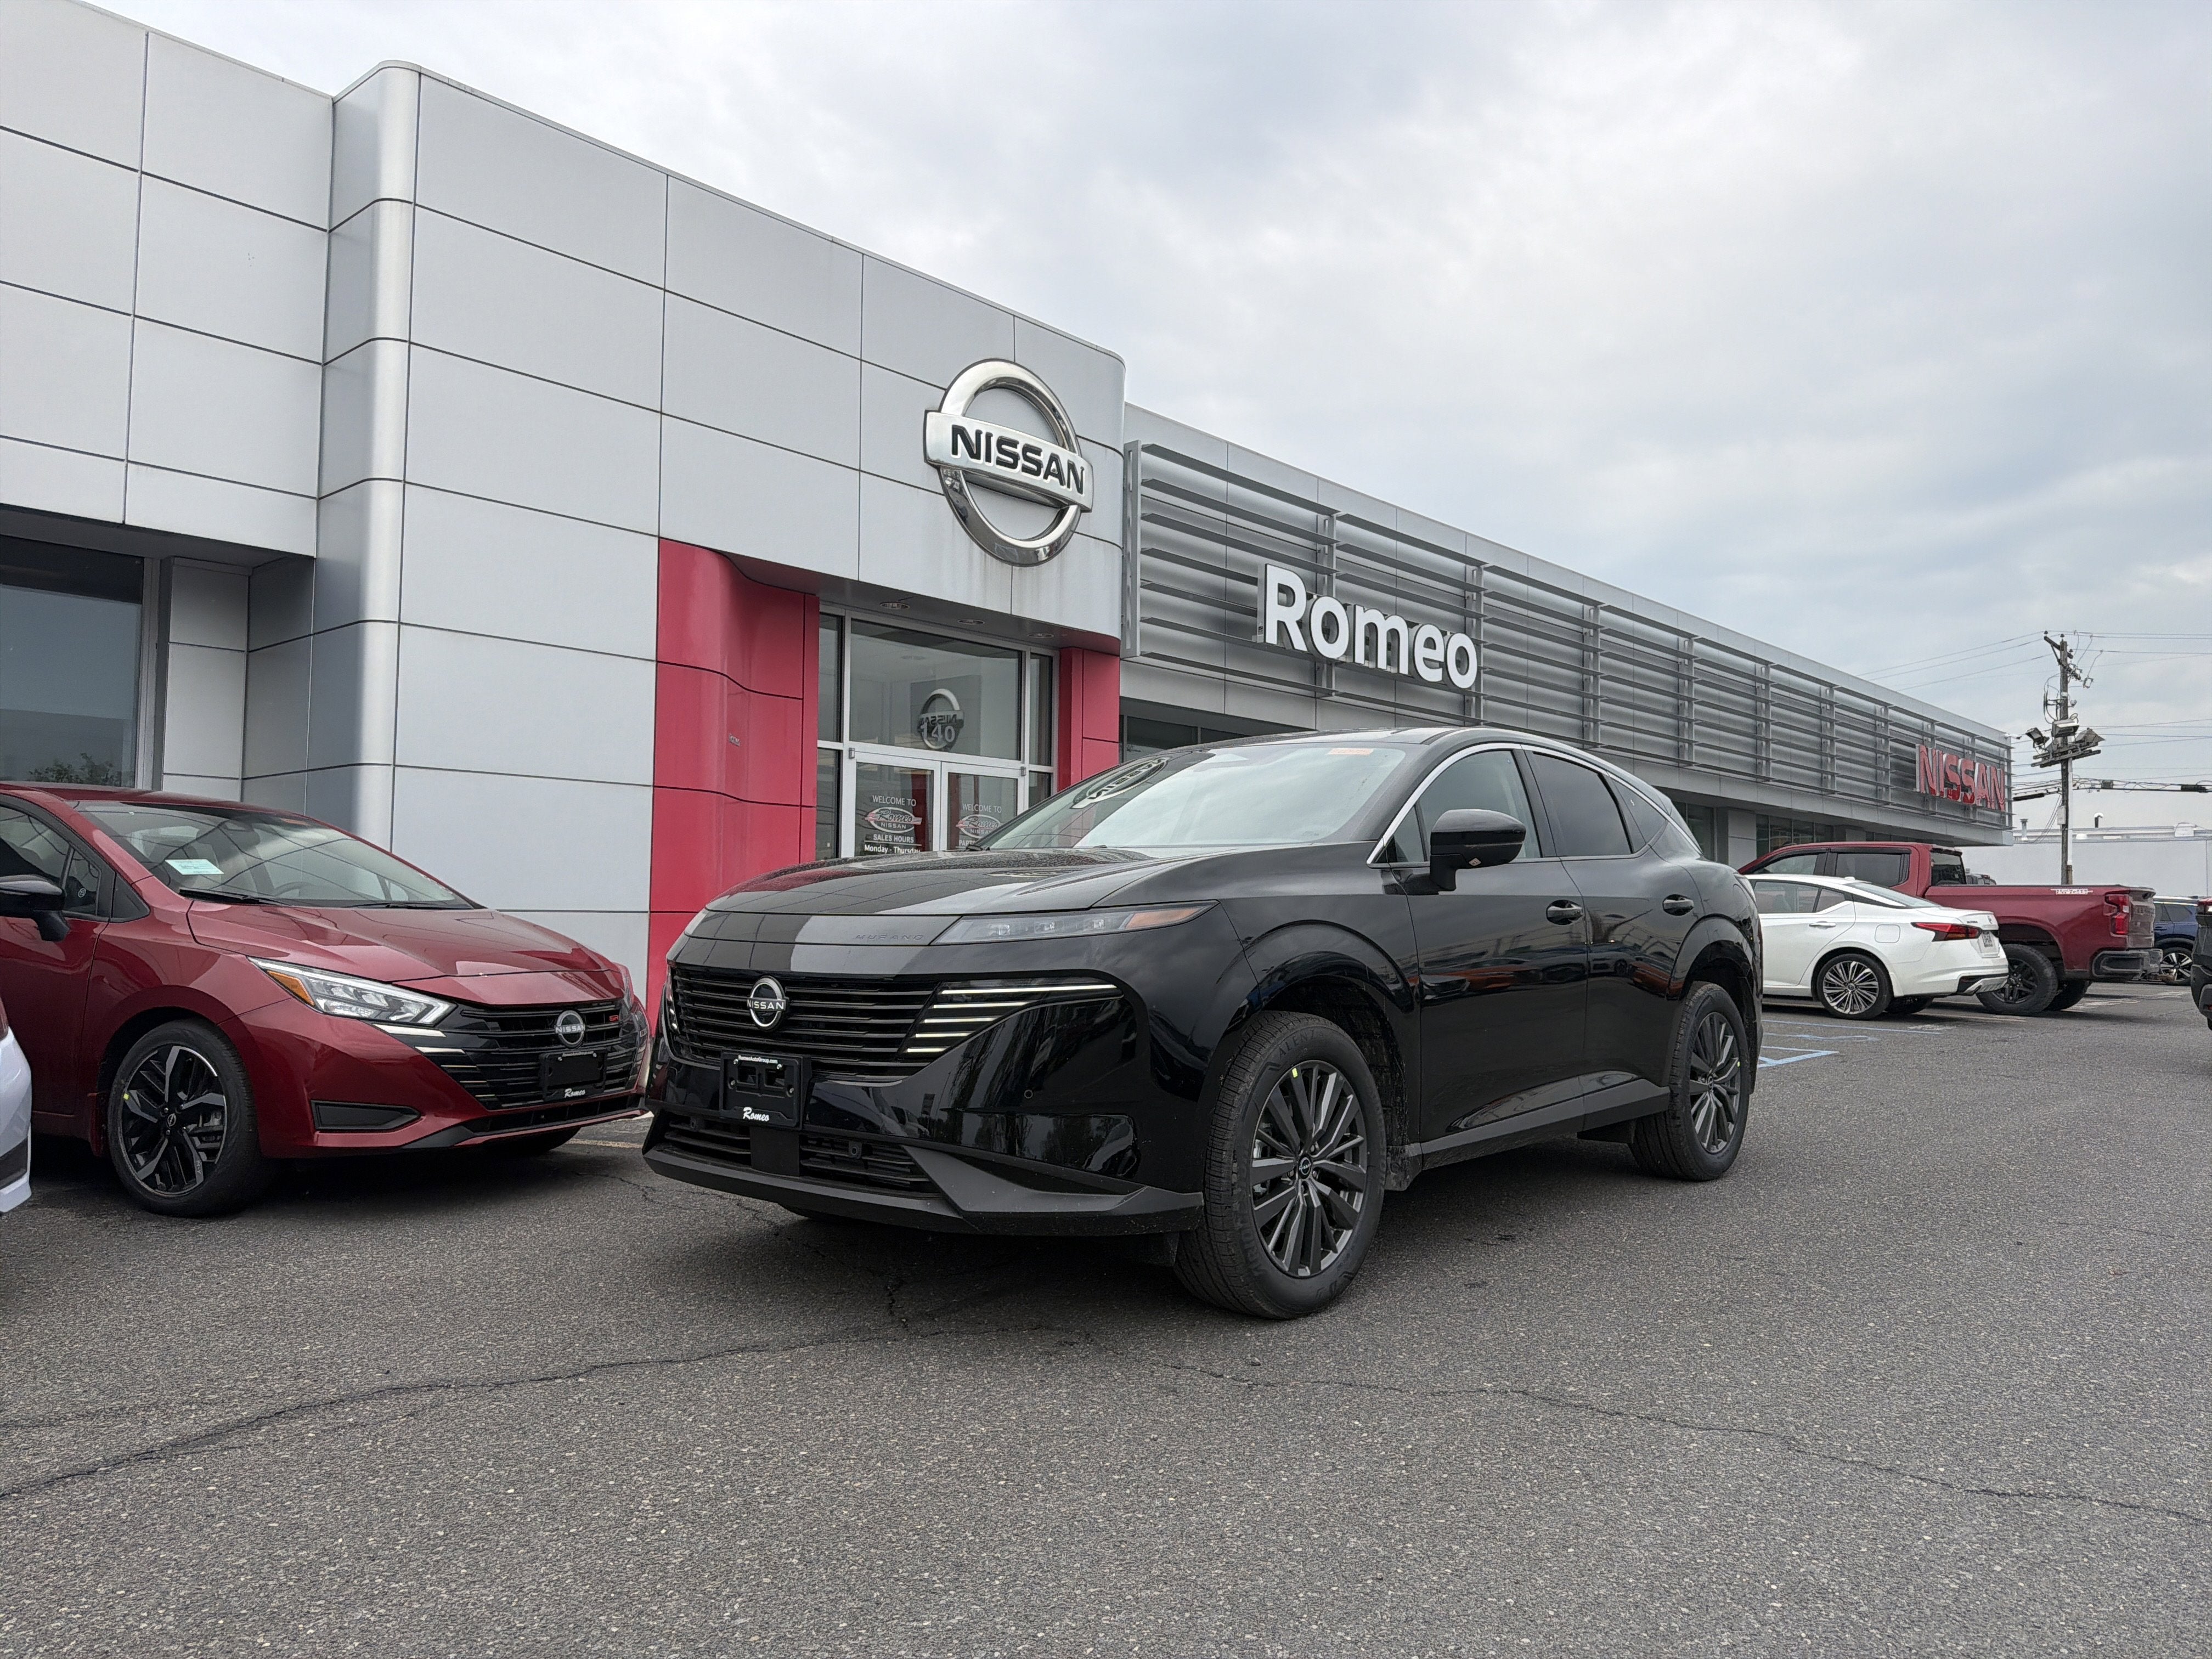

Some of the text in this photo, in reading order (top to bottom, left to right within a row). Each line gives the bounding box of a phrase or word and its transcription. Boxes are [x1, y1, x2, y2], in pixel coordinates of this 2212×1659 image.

[951, 424, 1085, 495] NISSAN
[1265, 563, 1478, 689] Romeo
[921, 722, 955, 742] 140
[1916, 744, 2006, 811] NISSAN
[872, 794, 917, 806] WELCOME TO
[962, 803, 992, 812] WELCOME
[878, 808, 913, 822] Romeo
[864, 844, 889, 854] Monday
[747, 999, 784, 1009] NISSAN
[555, 1024, 585, 1034] NISSAN
[1278, 1029, 1323, 1060] ALENZ
[564, 1088, 585, 1098] Romeo
[742, 1107, 770, 1122] Romeo
